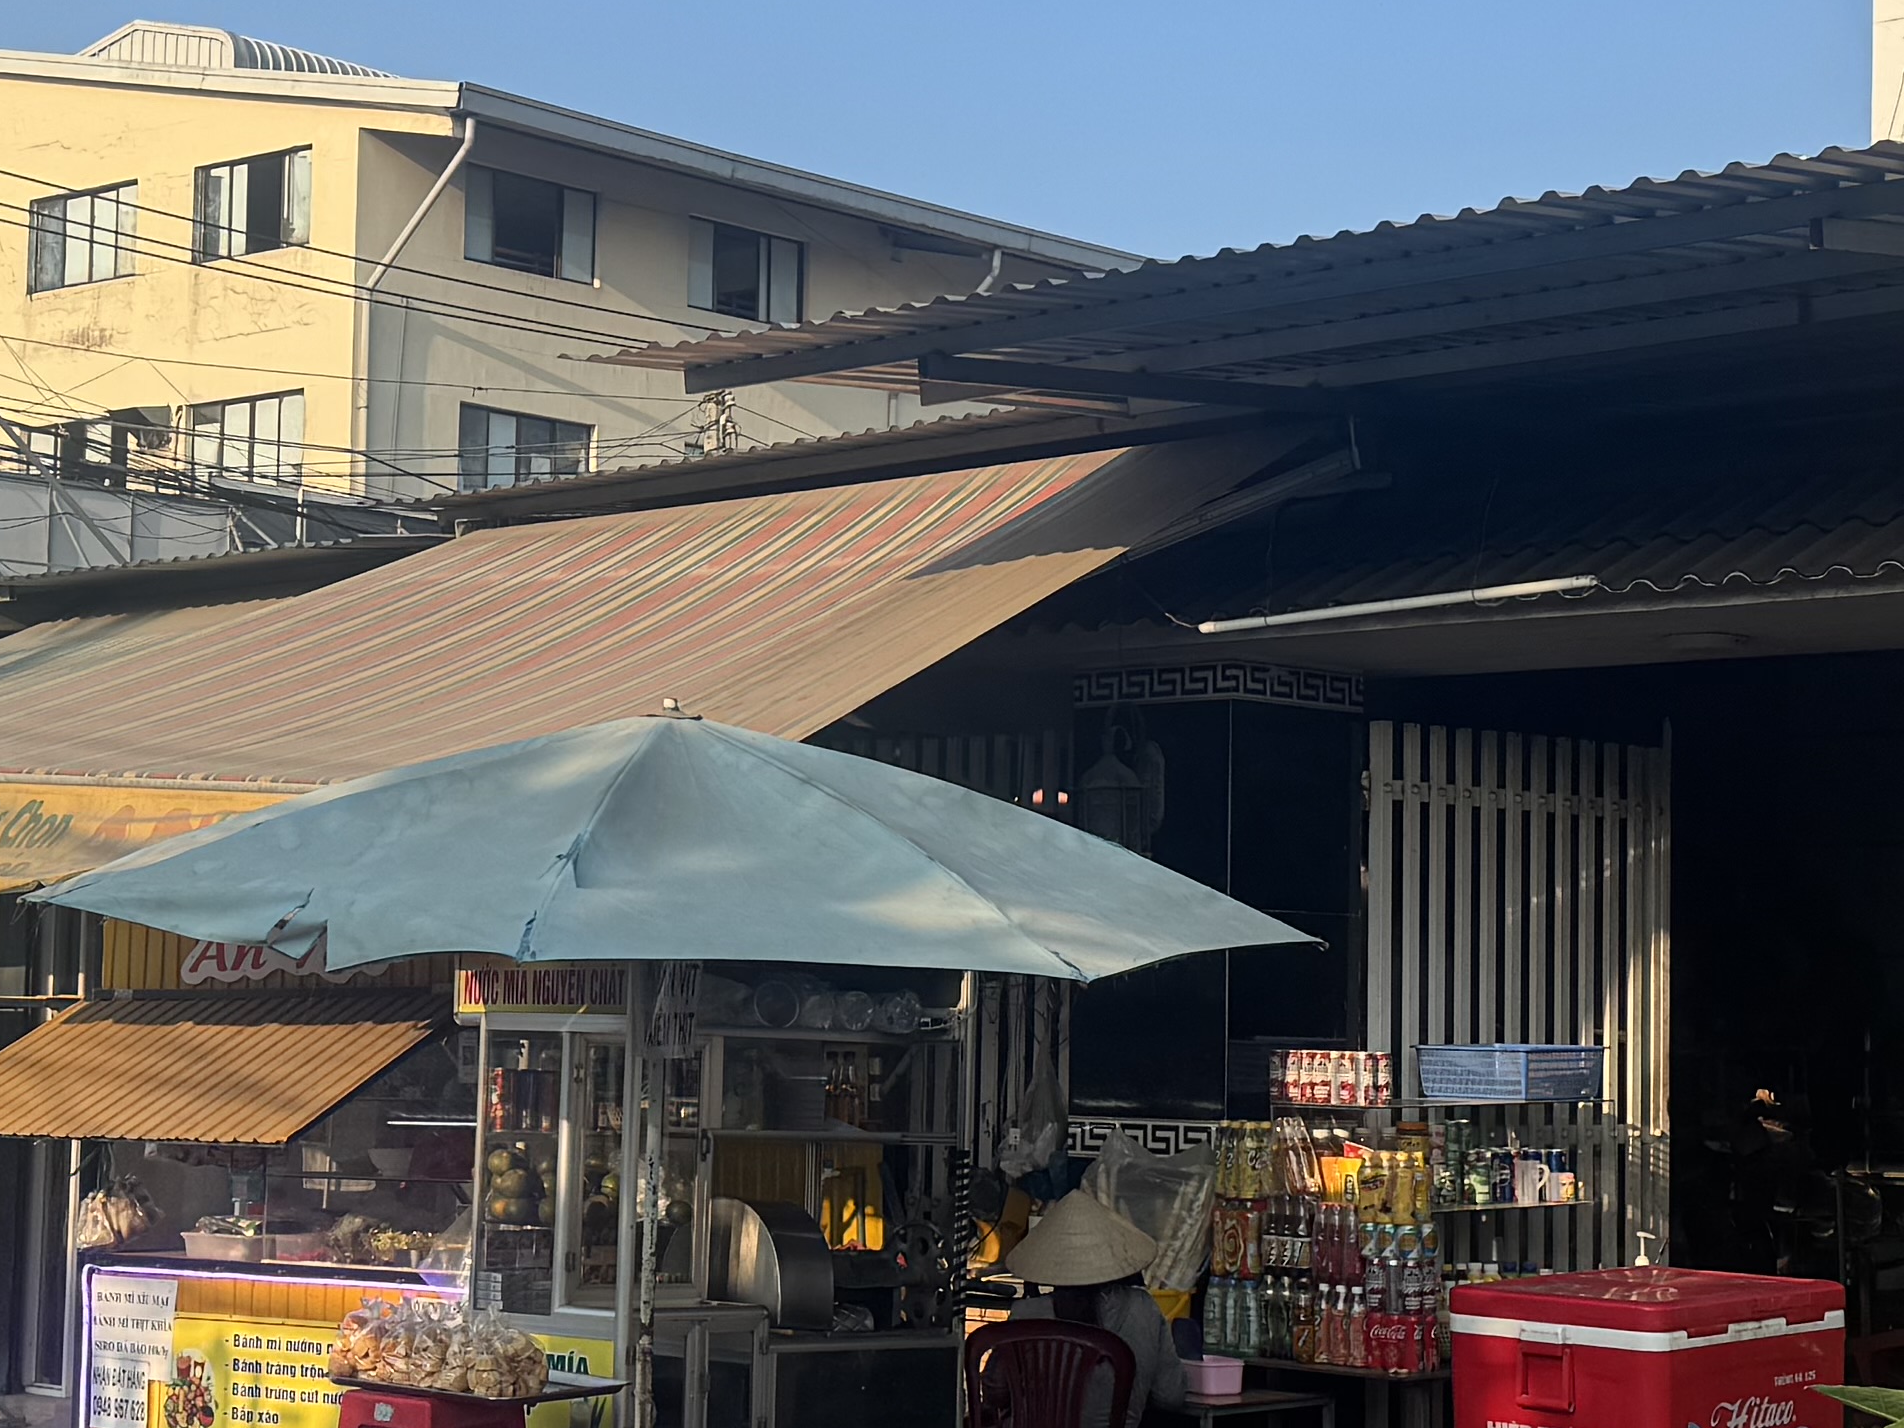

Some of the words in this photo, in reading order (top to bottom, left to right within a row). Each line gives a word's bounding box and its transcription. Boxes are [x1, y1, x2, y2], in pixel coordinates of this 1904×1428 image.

[233, 1333, 262, 1350] Bánh
[232, 1358, 262, 1374] Bánh
[232, 1382, 261, 1399] Bánh
[231, 1404, 254, 1423] Bắp
